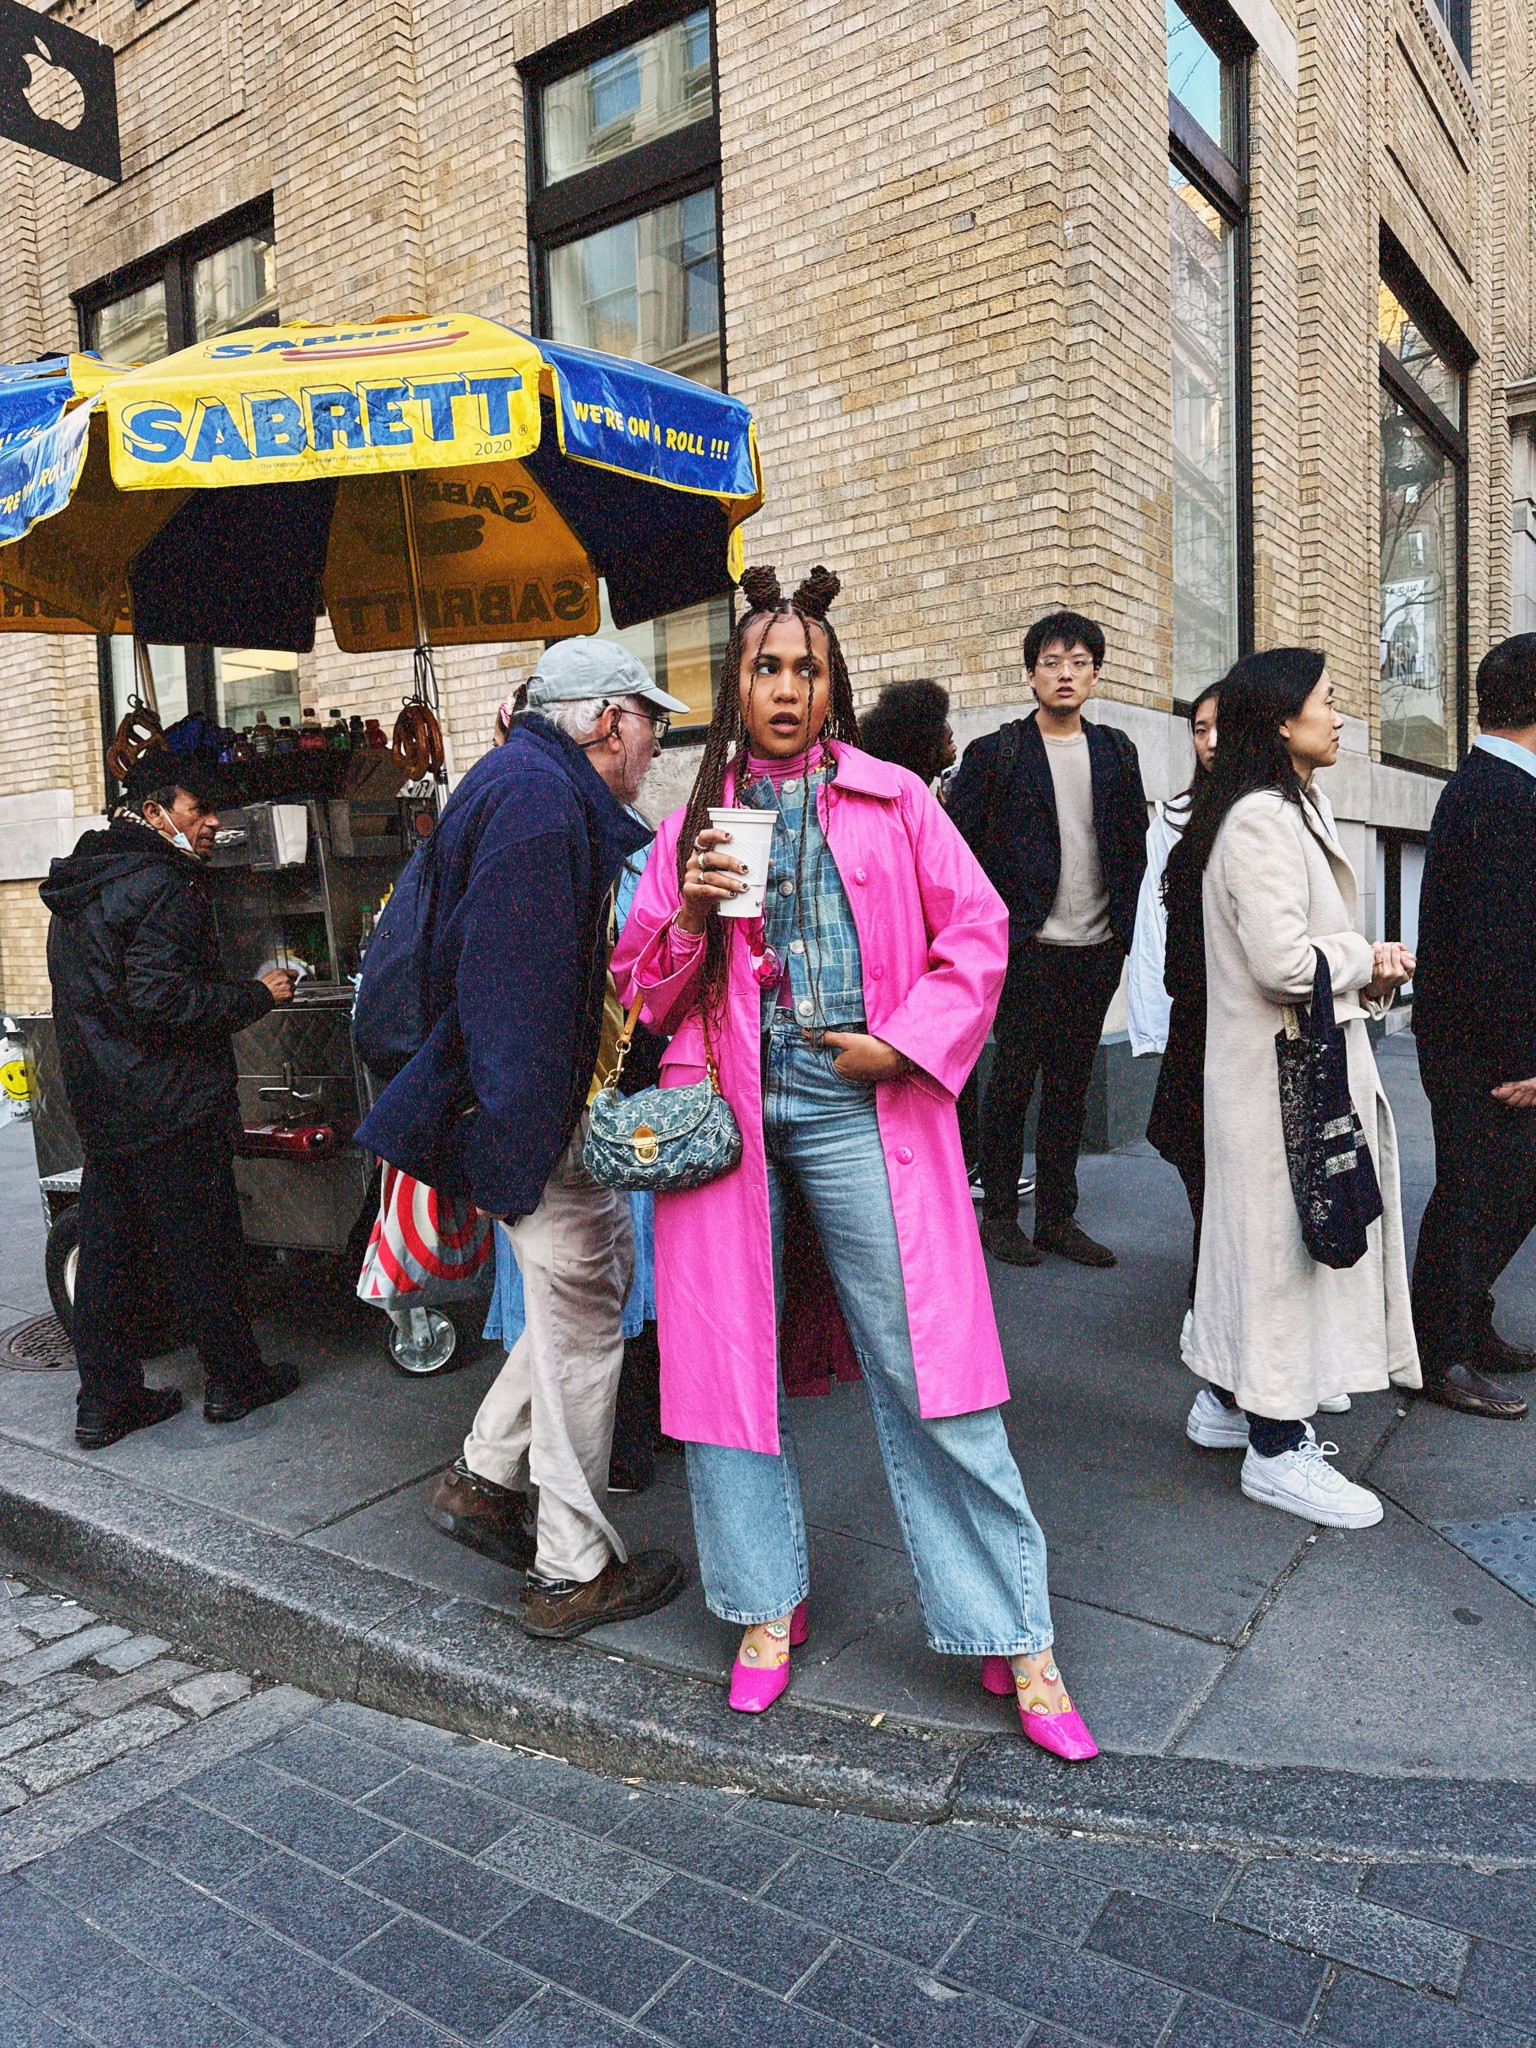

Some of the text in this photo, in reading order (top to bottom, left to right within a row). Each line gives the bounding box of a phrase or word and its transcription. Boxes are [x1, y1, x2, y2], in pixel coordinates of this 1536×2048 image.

[203, 320, 455, 359] SABRETT
[121, 368, 523, 463] SABRETT
[571, 400, 730, 460] WE'RE ON A ROLL !!!
[474, 440, 513, 456] 2020
